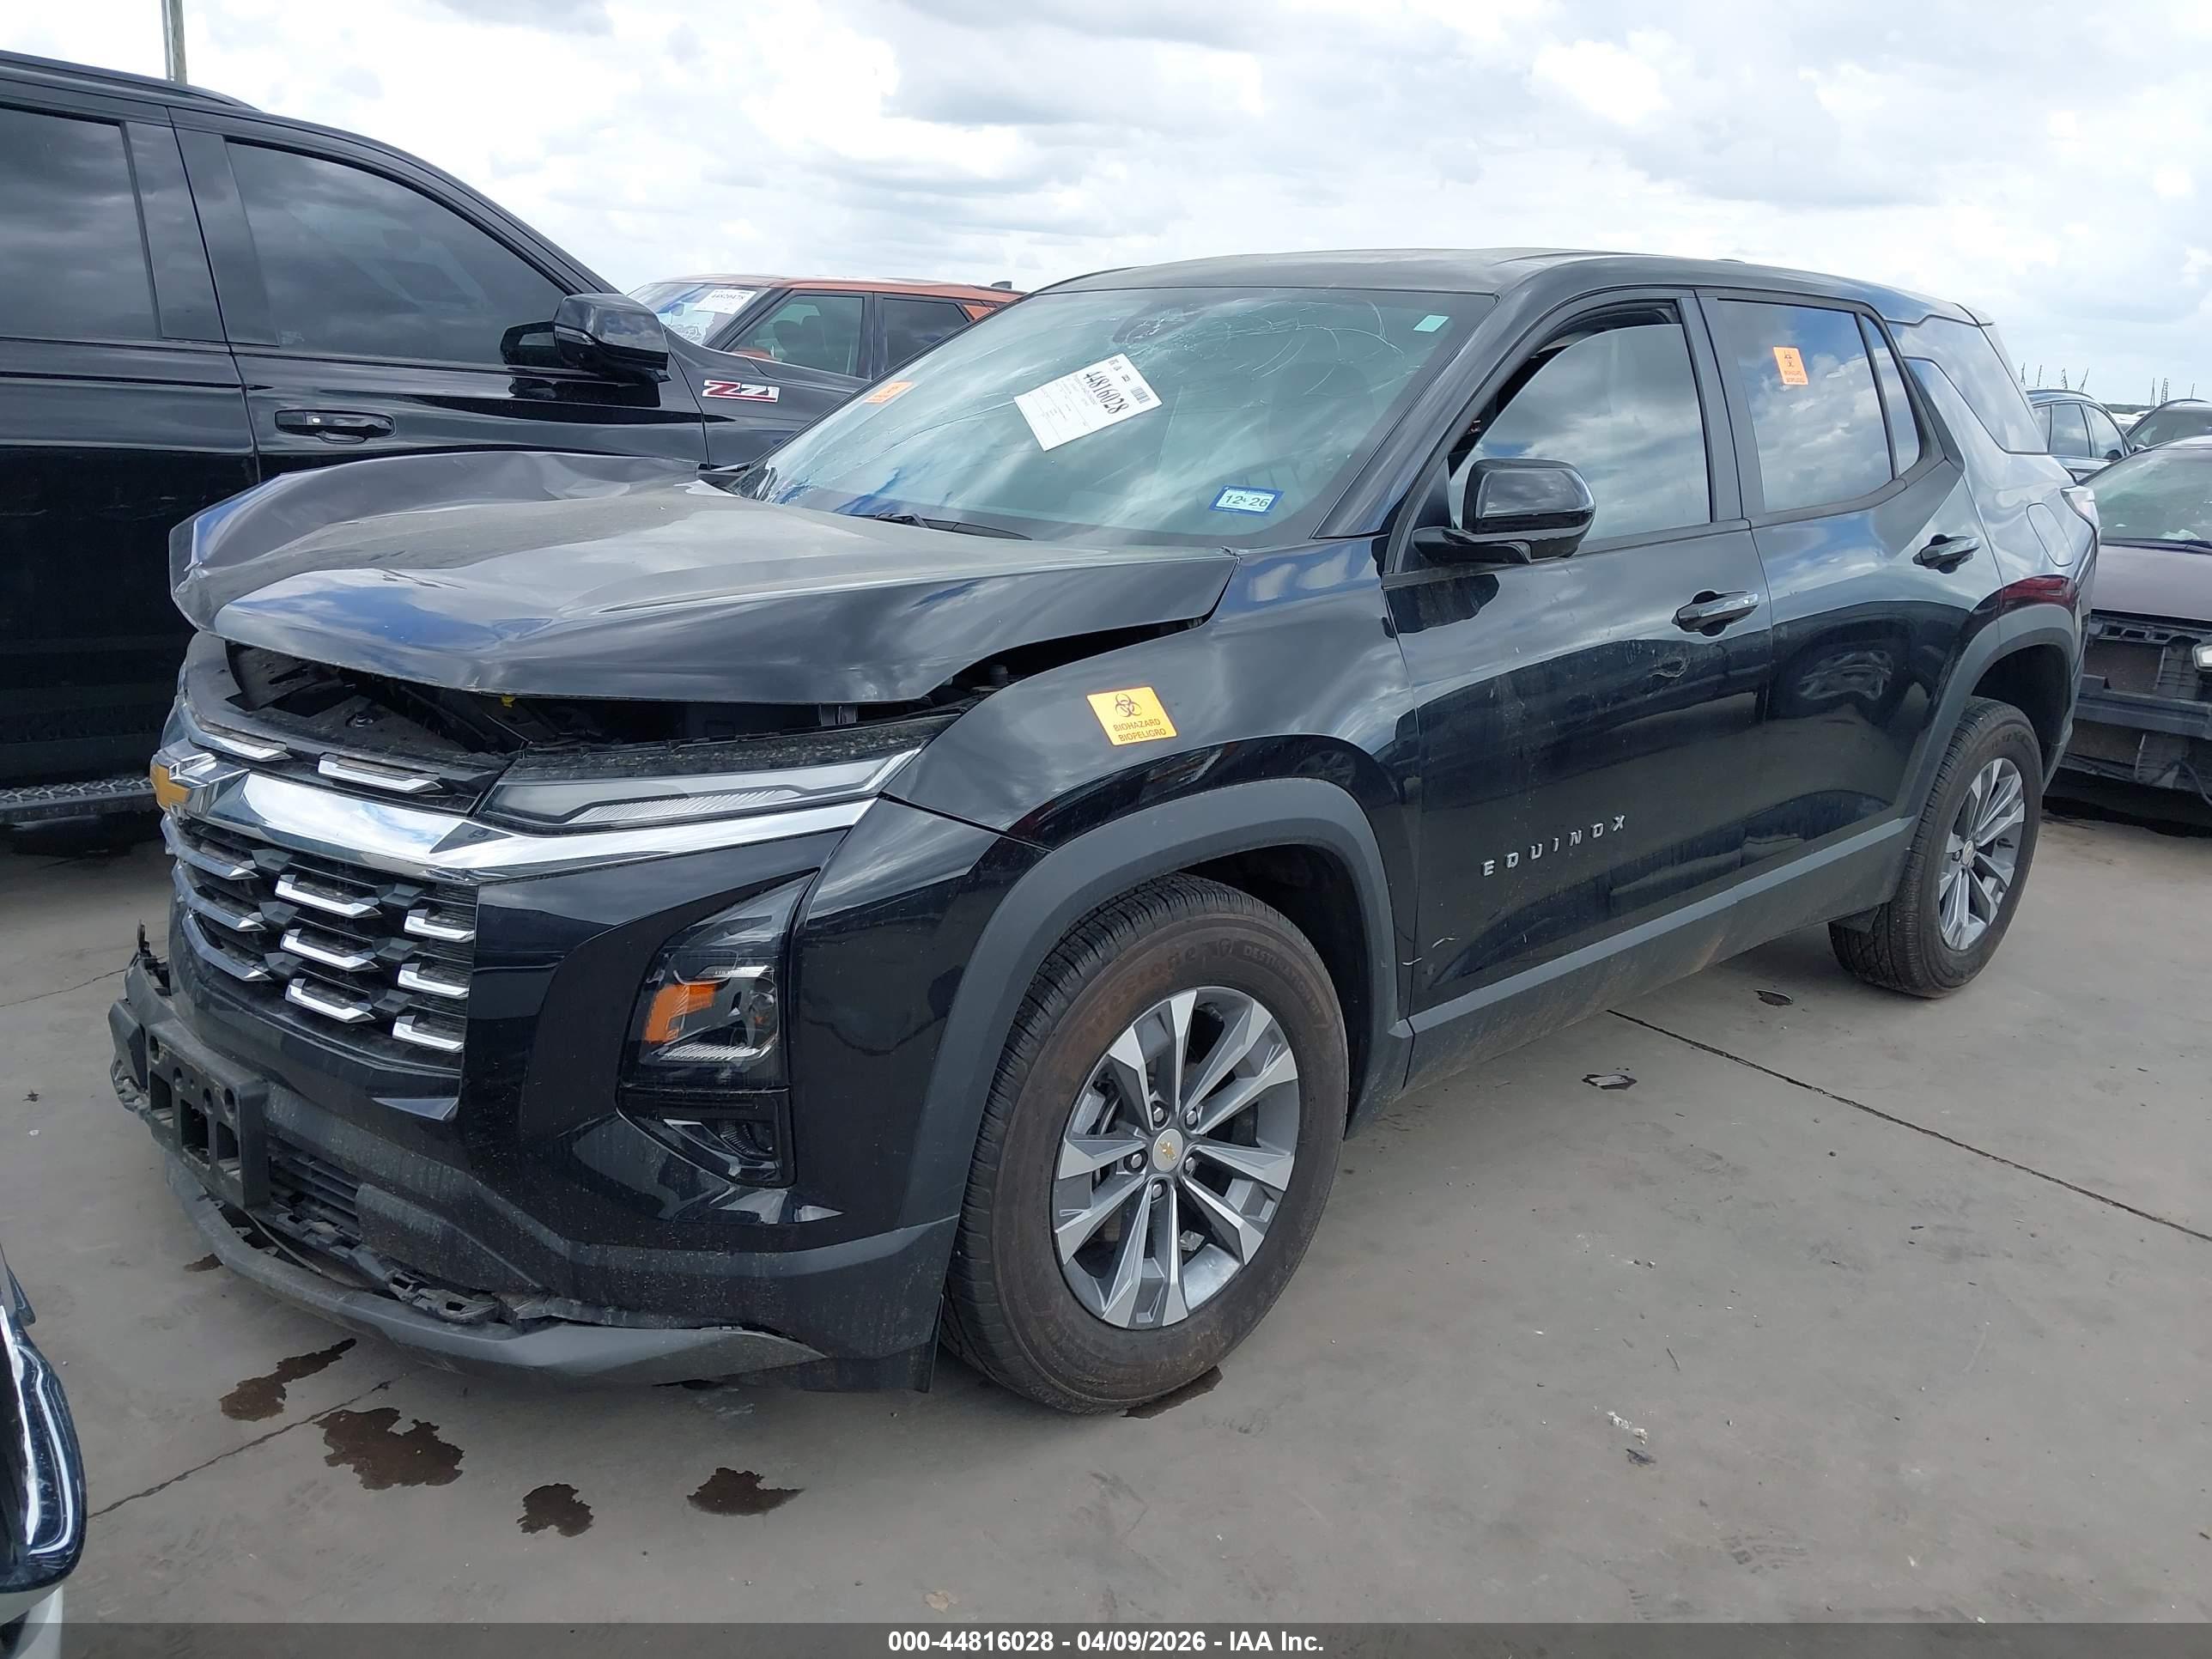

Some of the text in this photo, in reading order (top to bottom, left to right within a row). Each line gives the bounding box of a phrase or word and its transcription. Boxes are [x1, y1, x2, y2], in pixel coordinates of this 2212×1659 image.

[702, 380, 780, 403] Z71
[1083, 371, 1130, 415] 44816028
[1225, 495, 1243, 505] 12
[1249, 497, 1270, 507] 26
[1113, 719, 1161, 732] BIOHAZARD
[1118, 728, 1167, 742] BIOPELIGRO
[1482, 814, 1626, 878] EQUINOX
